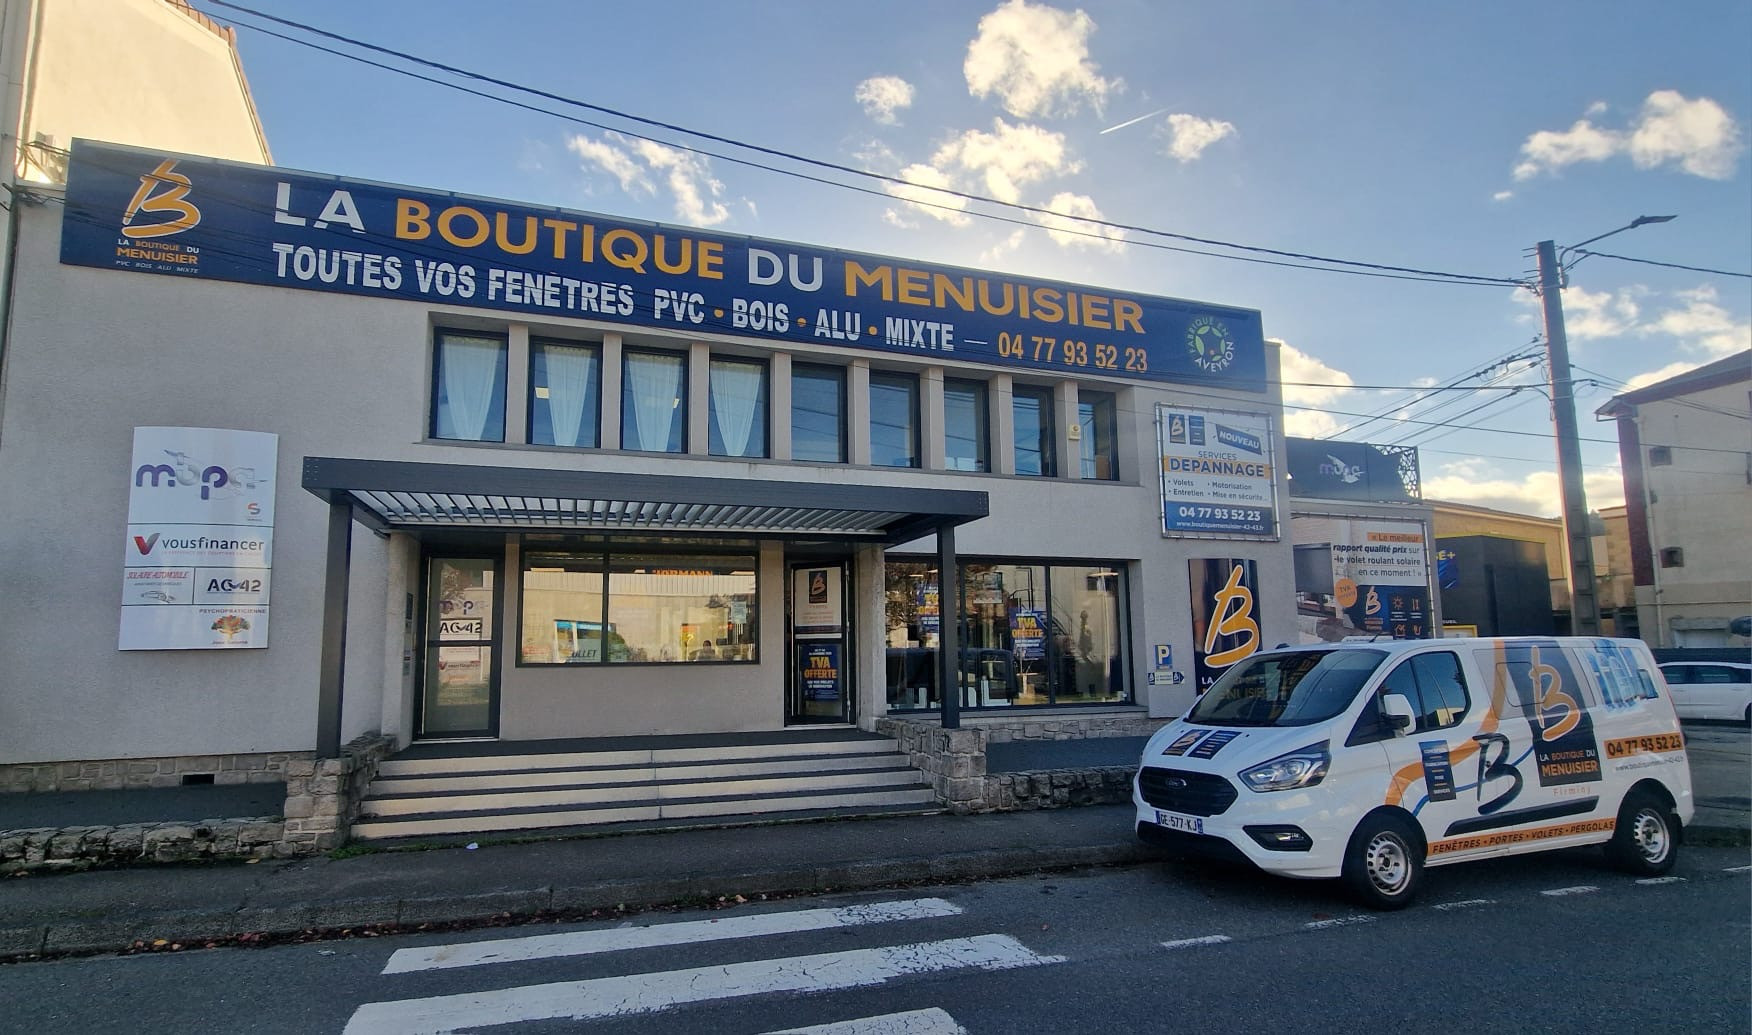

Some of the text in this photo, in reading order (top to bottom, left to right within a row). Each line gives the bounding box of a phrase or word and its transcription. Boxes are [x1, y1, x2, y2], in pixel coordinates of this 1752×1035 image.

[135, 240, 179, 252] BOUTIQUE
[186, 246, 200, 254] DU
[116, 248, 198, 264] MENUISIER
[274, 182, 1146, 334] LA BOUTIQUE DU MENUISIER
[272, 242, 402, 290] TOUTES
[415, 259, 476, 298] VOS
[654, 288, 705, 324] PVC
[732, 298, 790, 334] BOIS
[814, 308, 861, 341] ALU
[885, 316, 954, 351] MIXTE
[998, 332, 1024, 358] 04
[1032, 336, 1056, 362] 77
[1064, 340, 1088, 366] 93
[1095, 344, 1118, 370] 52
[1126, 348, 1148, 373] 23
[1194, 342, 1234, 372] AVEYRON
[1219, 430, 1260, 449] NOUVEAU
[1198, 450, 1238, 460] SERVICES
[1170, 458, 1265, 477] DEPANNAGE
[1173, 479, 1252, 490] Volets Motorisation
[1174, 488, 1204, 497] Entretien
[1180, 506, 1260, 522] 04 77 93 52 23
[162, 536, 265, 551] vousfinancer
[1333, 544, 1363, 553] rapport
[1364, 544, 1392, 554] qualité
[1392, 545, 1408, 554] prix
[1347, 555, 1366, 564] volet
[1368, 556, 1394, 564] roulant
[1396, 557, 1421, 566] solaire
[1358, 568, 1368, 576] en
[1380, 568, 1412, 577] moment
[1016, 617, 1037, 628] TVA
[1011, 628, 1044, 638] OFFERTE
[810, 656, 831, 668] TVA
[1158, 646, 1170, 664] P
[804, 668, 838, 678] OFFERTE
[1202, 676, 1214, 685] LA
[1608, 735, 1681, 756] 04 77 93 52 23
[1540, 749, 1596, 762] LA BOUTIQUE DU
[1542, 760, 1599, 777] MENUISIER
[1490, 834, 1524, 846] PORTES
[1531, 828, 1563, 840] VOLETS
[1570, 820, 1616, 833] PERGOLAS
